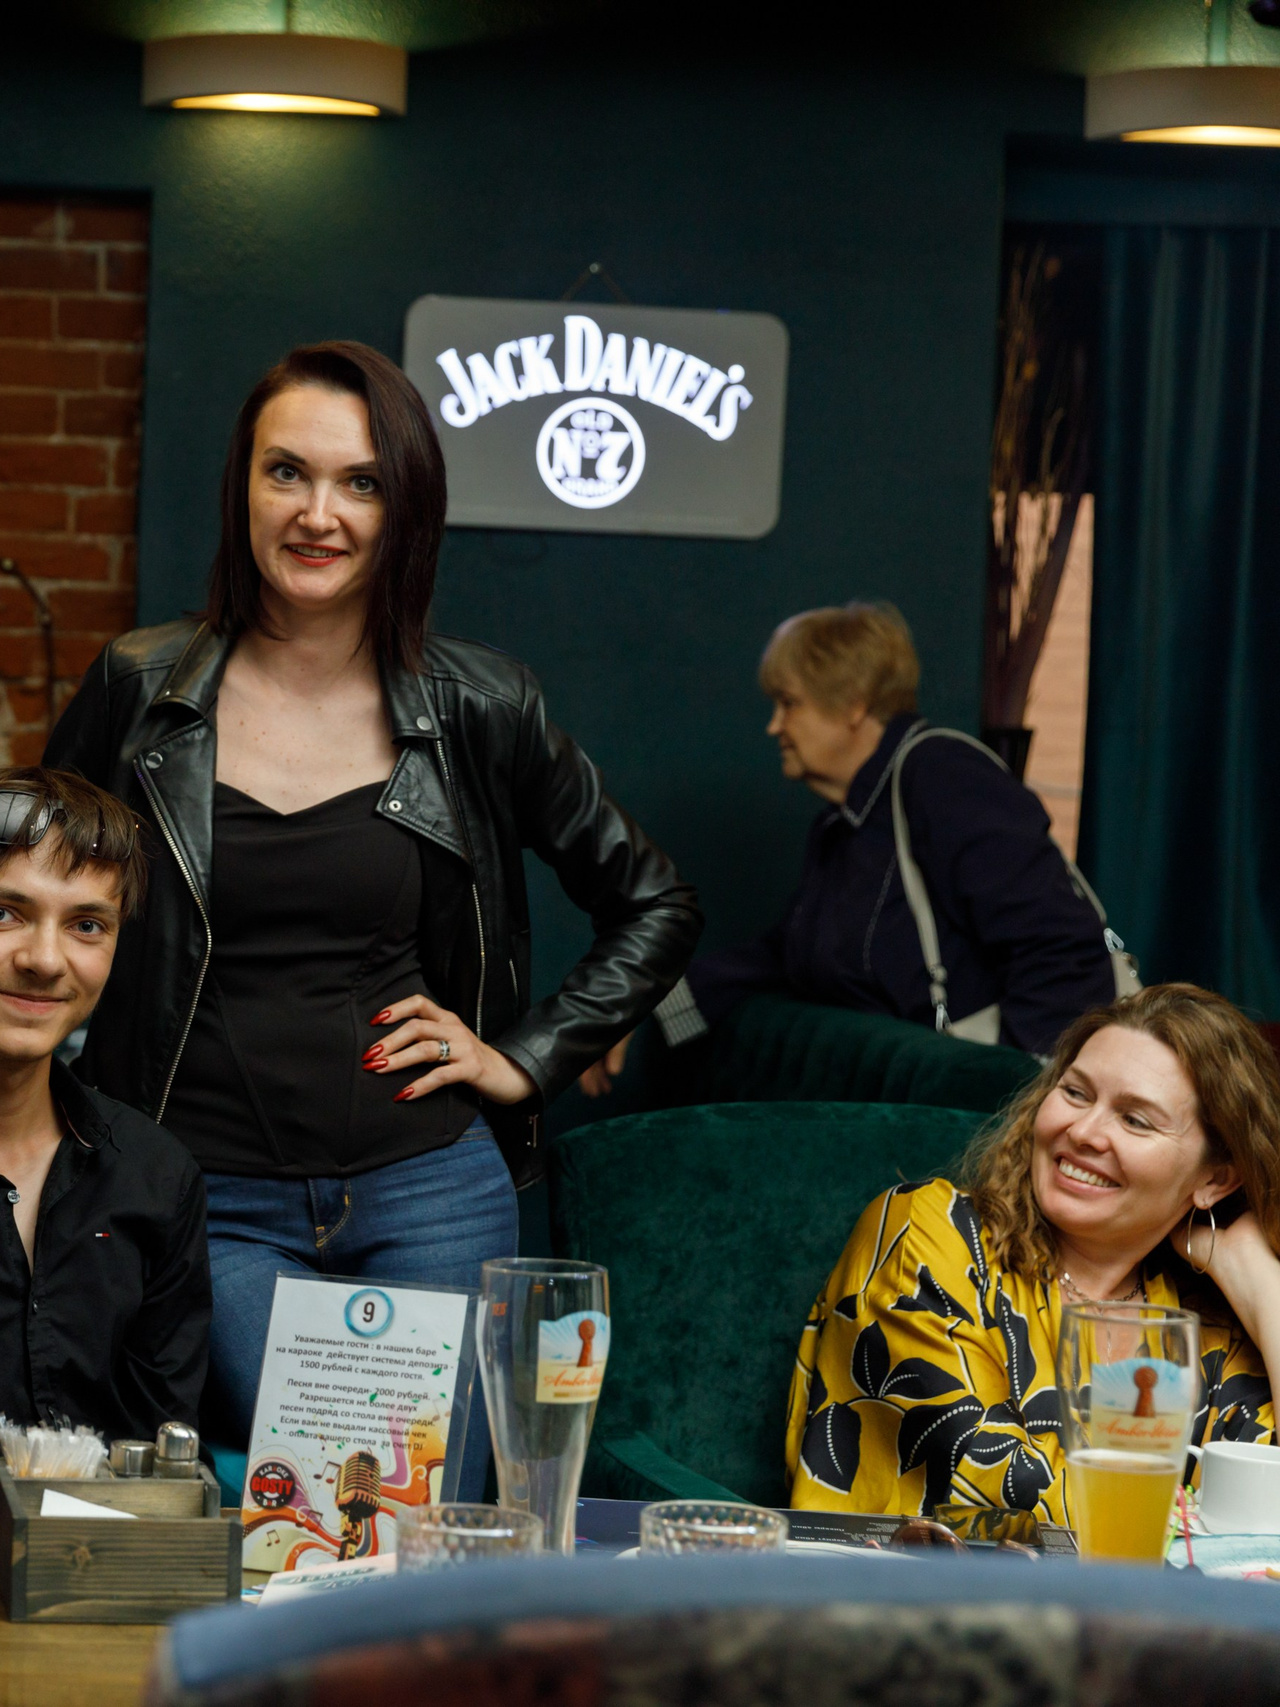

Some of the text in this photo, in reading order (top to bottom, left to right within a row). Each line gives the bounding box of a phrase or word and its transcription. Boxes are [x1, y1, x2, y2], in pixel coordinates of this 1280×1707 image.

[363, 1302, 375, 1322] 9
[295, 1335, 344, 1346] Уважаемые
[347, 1341, 369, 1349] гости
[384, 1344, 413, 1353] нашем
[416, 1347, 436, 1356] баре
[288, 1347, 322, 1357] караоке
[327, 1350, 369, 1362] действует
[371, 1355, 405, 1365] система
[408, 1360, 448, 1370] депозита
[300, 1361, 319, 1369] 1500
[322, 1363, 352, 1373] рублей
[361, 1367, 398, 1378] каждого
[401, 1372, 424, 1380] гостя.
[287, 1379, 312, 1388] Песня
[375, 1388, 395, 1397] 2000
[397, 1389, 430, 1400] рублей.
[300, 1393, 354, 1405] Разрешается
[370, 1400, 395, 1409] более
[398, 1404, 417, 1412] двух
[280, 1404, 304, 1412] песен
[306, 1407, 338, 1417] подряд
[396, 1417, 435, 1427] очереди.
[333, 1423, 366, 1432] выдали
[369, 1426, 409, 1436] кассовый
[289, 1431, 318, 1439] оплата
[320, 1434, 350, 1443] вашего
[353, 1438, 376, 1446] стола
[414, 1443, 422, 1451] DJ
[259, 1465, 290, 1478] KARAOKE
[252, 1475, 293, 1495] GOSTY
[263, 1498, 277, 1507] BAR
